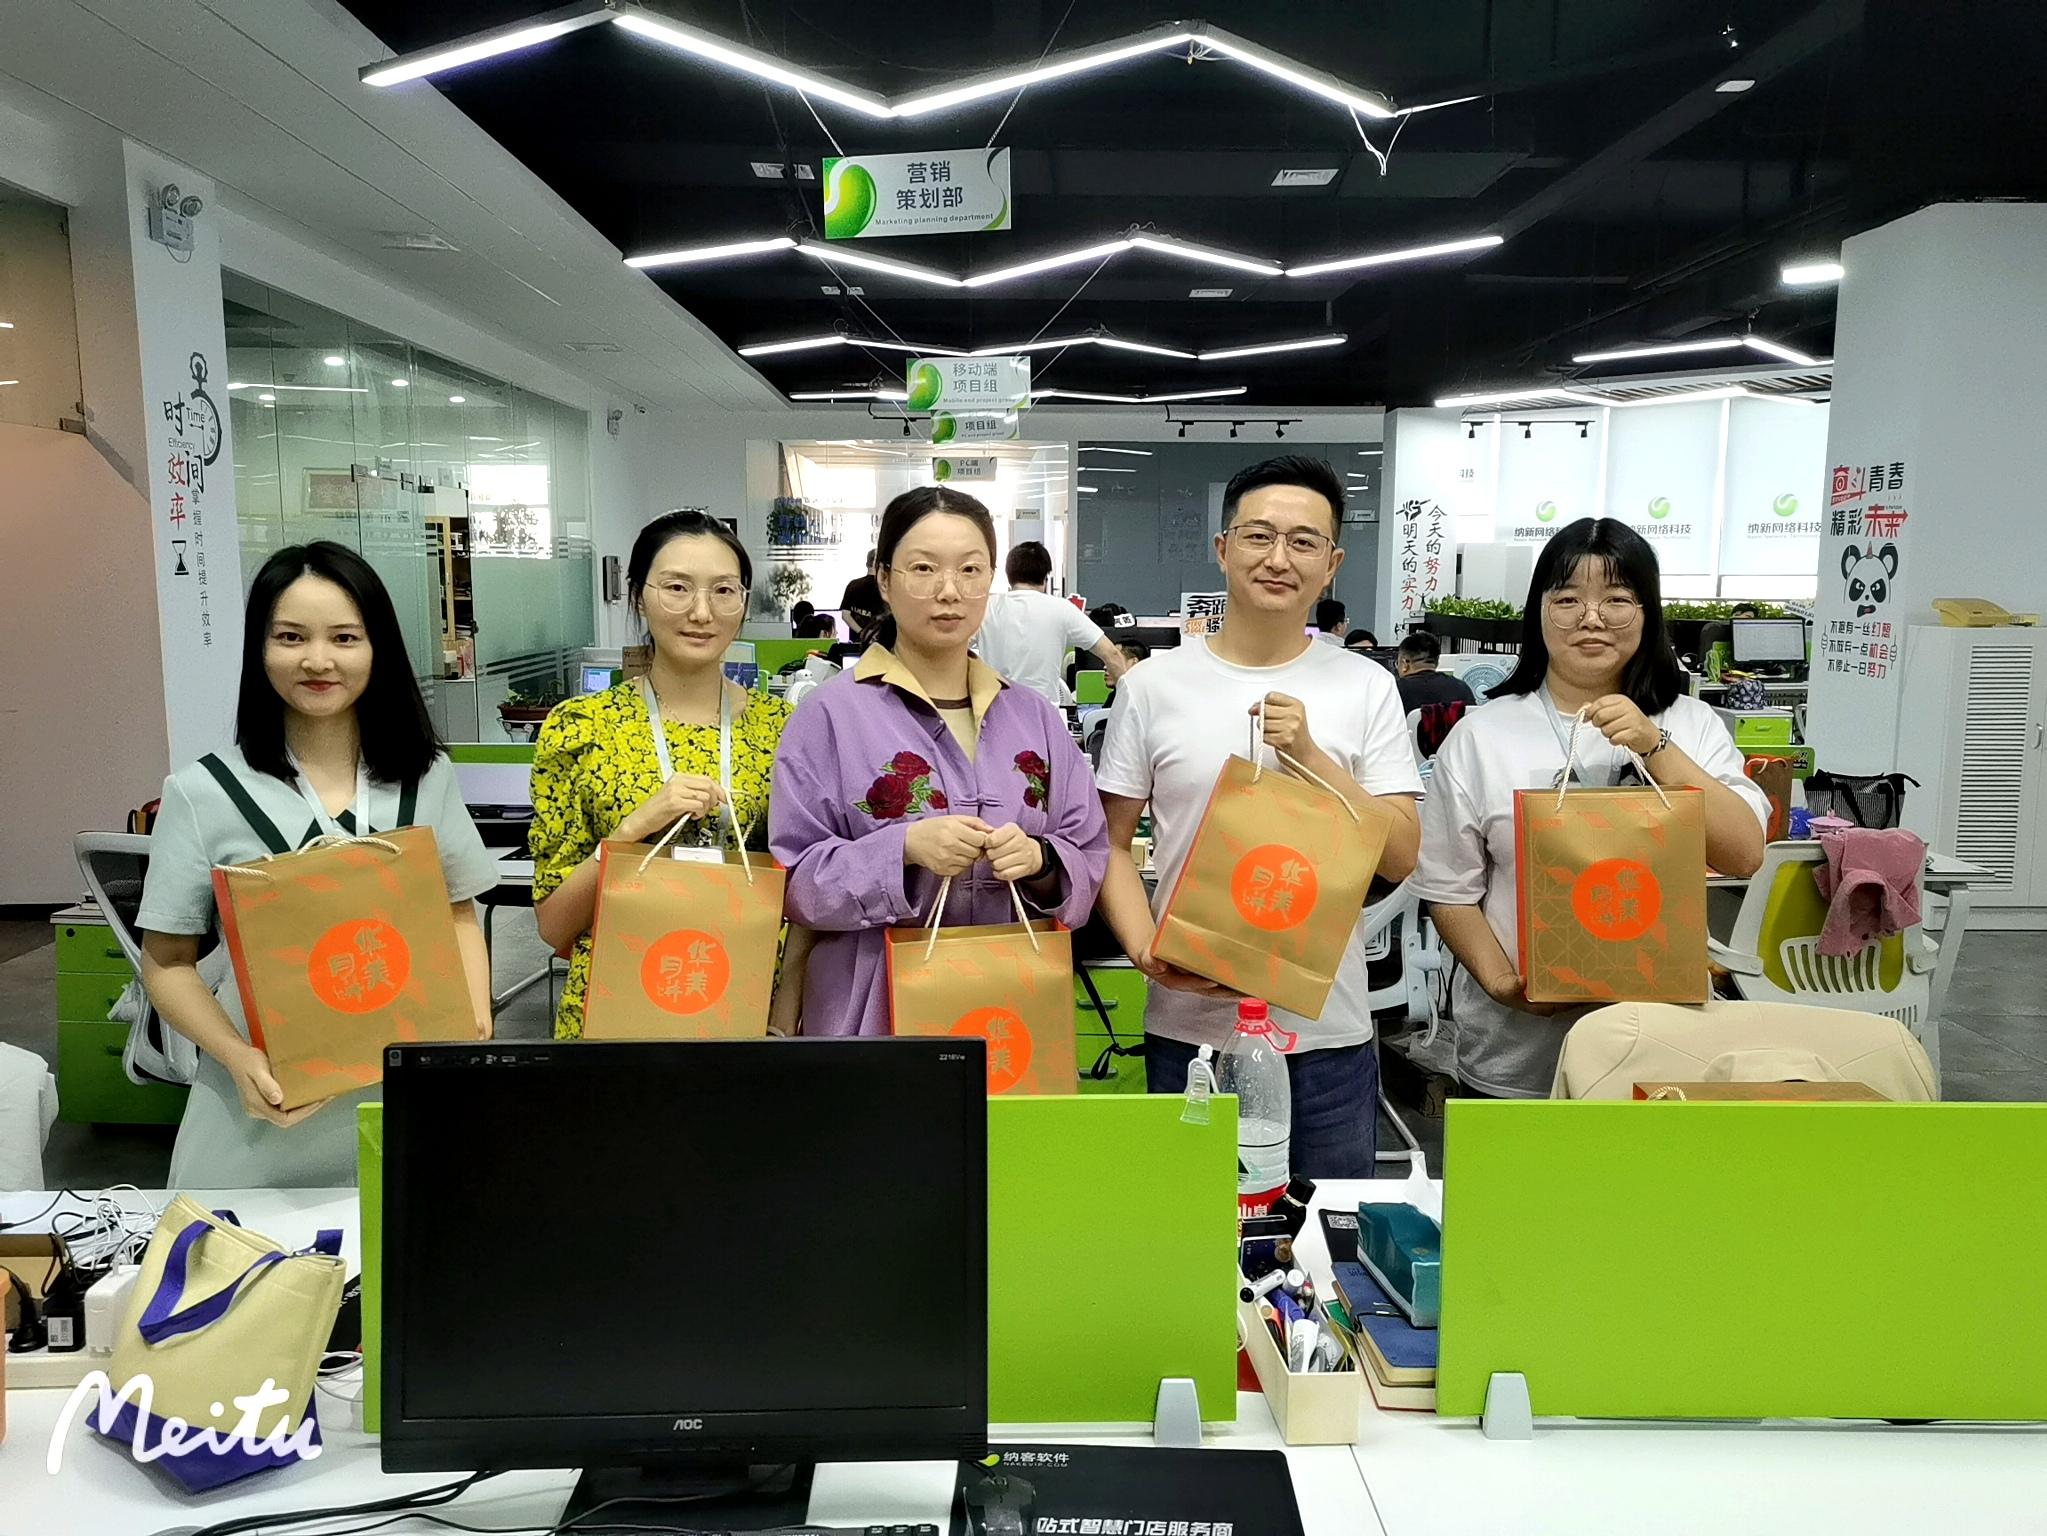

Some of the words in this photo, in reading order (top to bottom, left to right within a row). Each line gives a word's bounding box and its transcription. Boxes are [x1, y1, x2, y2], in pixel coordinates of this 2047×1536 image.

[907, 160, 951, 184] 营销
[896, 186, 964, 210] 策划部
[875, 217, 913, 226] Marketing
[914, 215, 948, 225] planning
[949, 213, 994, 223] department
[953, 362, 998, 377] 移动端
[953, 379, 998, 393] 项目组
[186, 407, 206, 424] Time
[965, 419, 997, 431] 项目组
[168, 453, 186, 531] 效率
[1747, 522, 1821, 534] 纳新网络科技
[1830, 504, 1908, 538] 精彩未来
[1423, 504, 1448, 592] 今天的努力
[1401, 522, 1420, 611] 明天的实力
[1830, 620, 1892, 639] 不抱有一丝幻想
[1828, 640, 1889, 660] 不放弃一点机会
[1827, 659, 1887, 680] 不停止一日努力
[673, 1418, 703, 1431] AOC
[1003, 1452, 1070, 1463] 纳客软件
